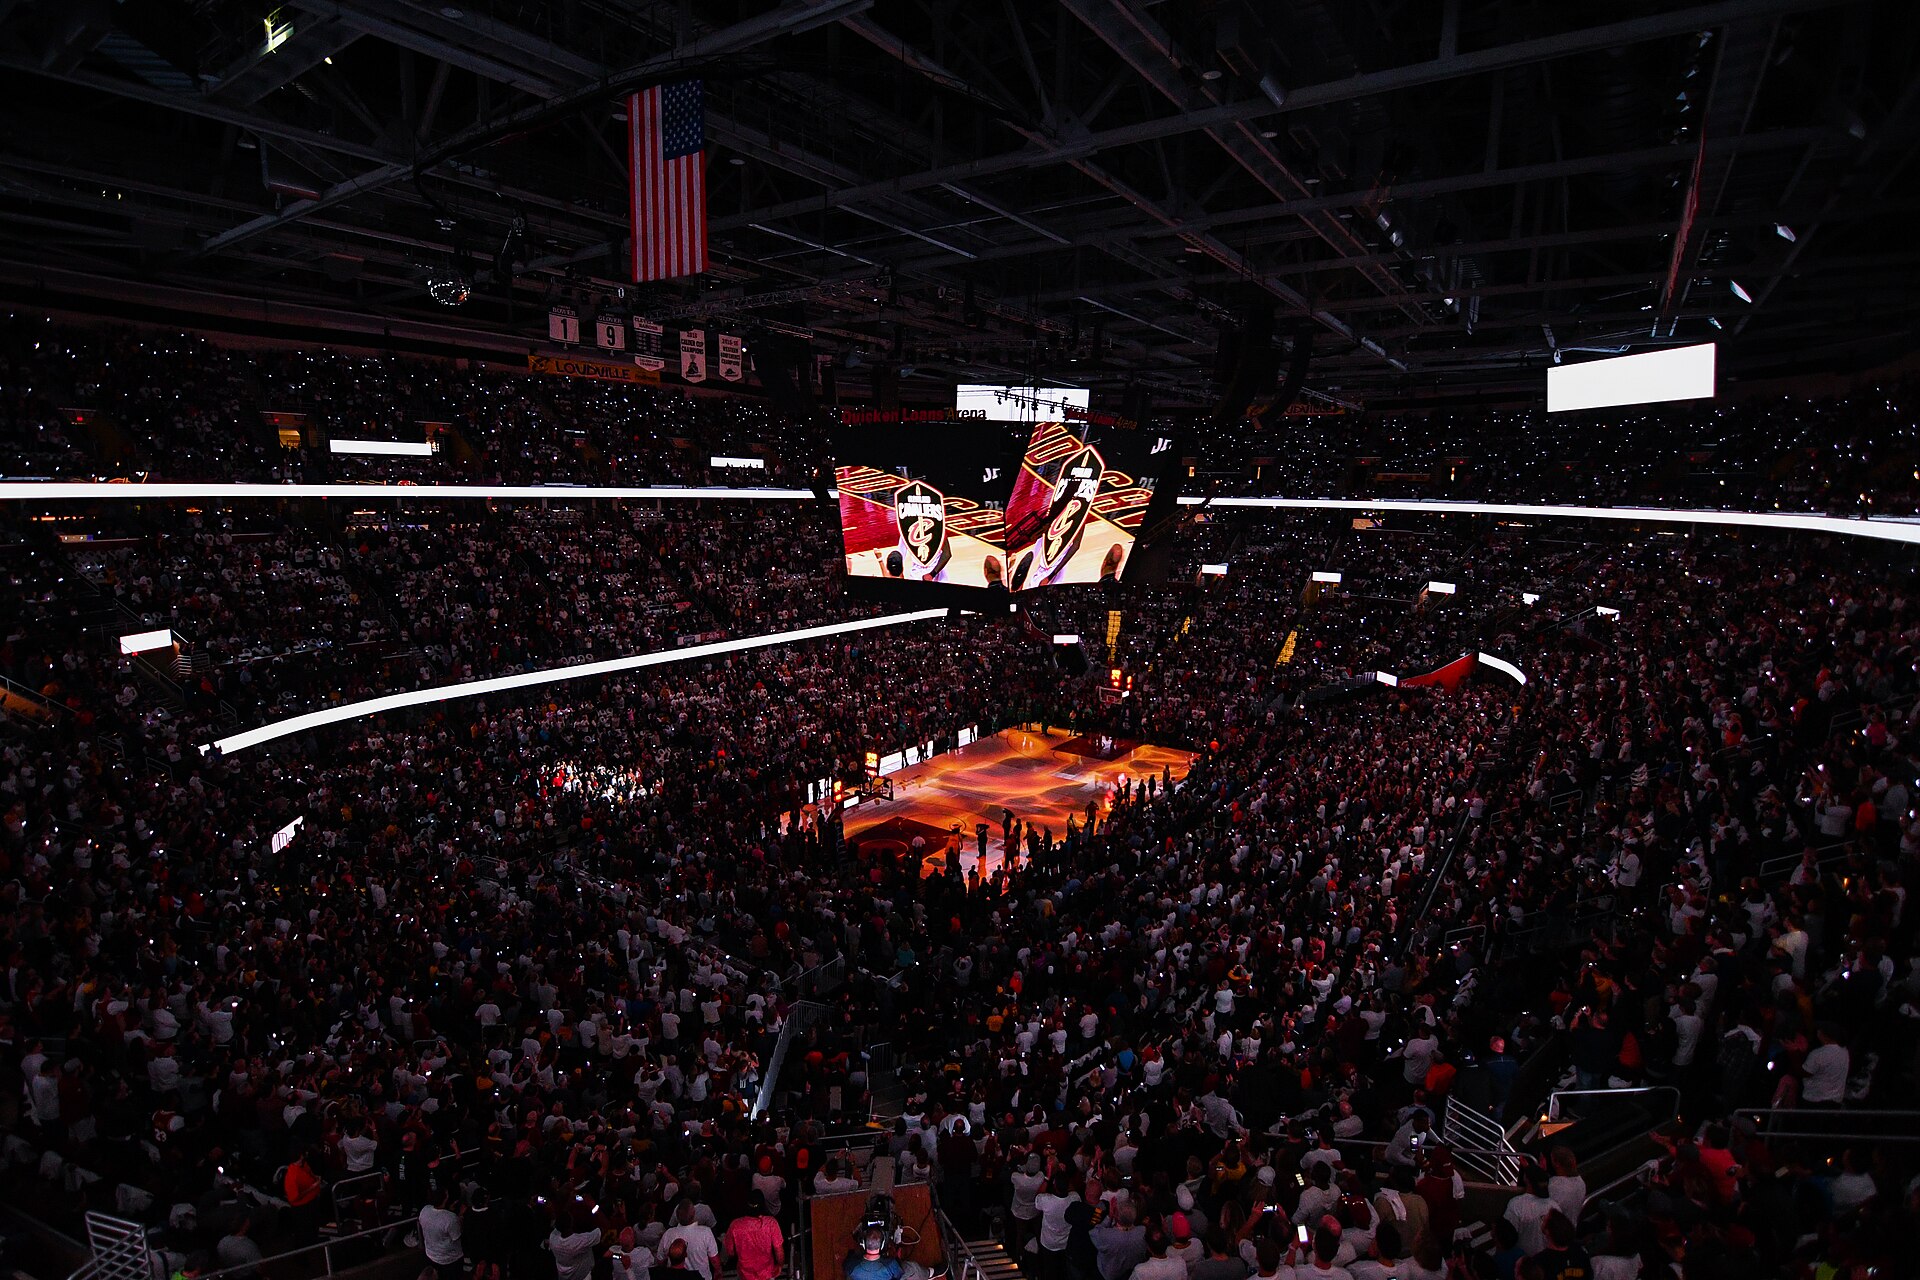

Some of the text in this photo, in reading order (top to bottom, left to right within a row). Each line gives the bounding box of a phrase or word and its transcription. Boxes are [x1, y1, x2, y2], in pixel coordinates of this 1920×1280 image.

[561, 318, 567, 339] 1
[606, 326, 615, 346] 9
[681, 346, 704, 355] CHAMPIONS
[555, 361, 631, 379] LOUDVILLE
[841, 407, 987, 426] Quicken Loans Arena
[1115, 416, 1138, 430] Arena
[154, 1128, 167, 1143] 23
